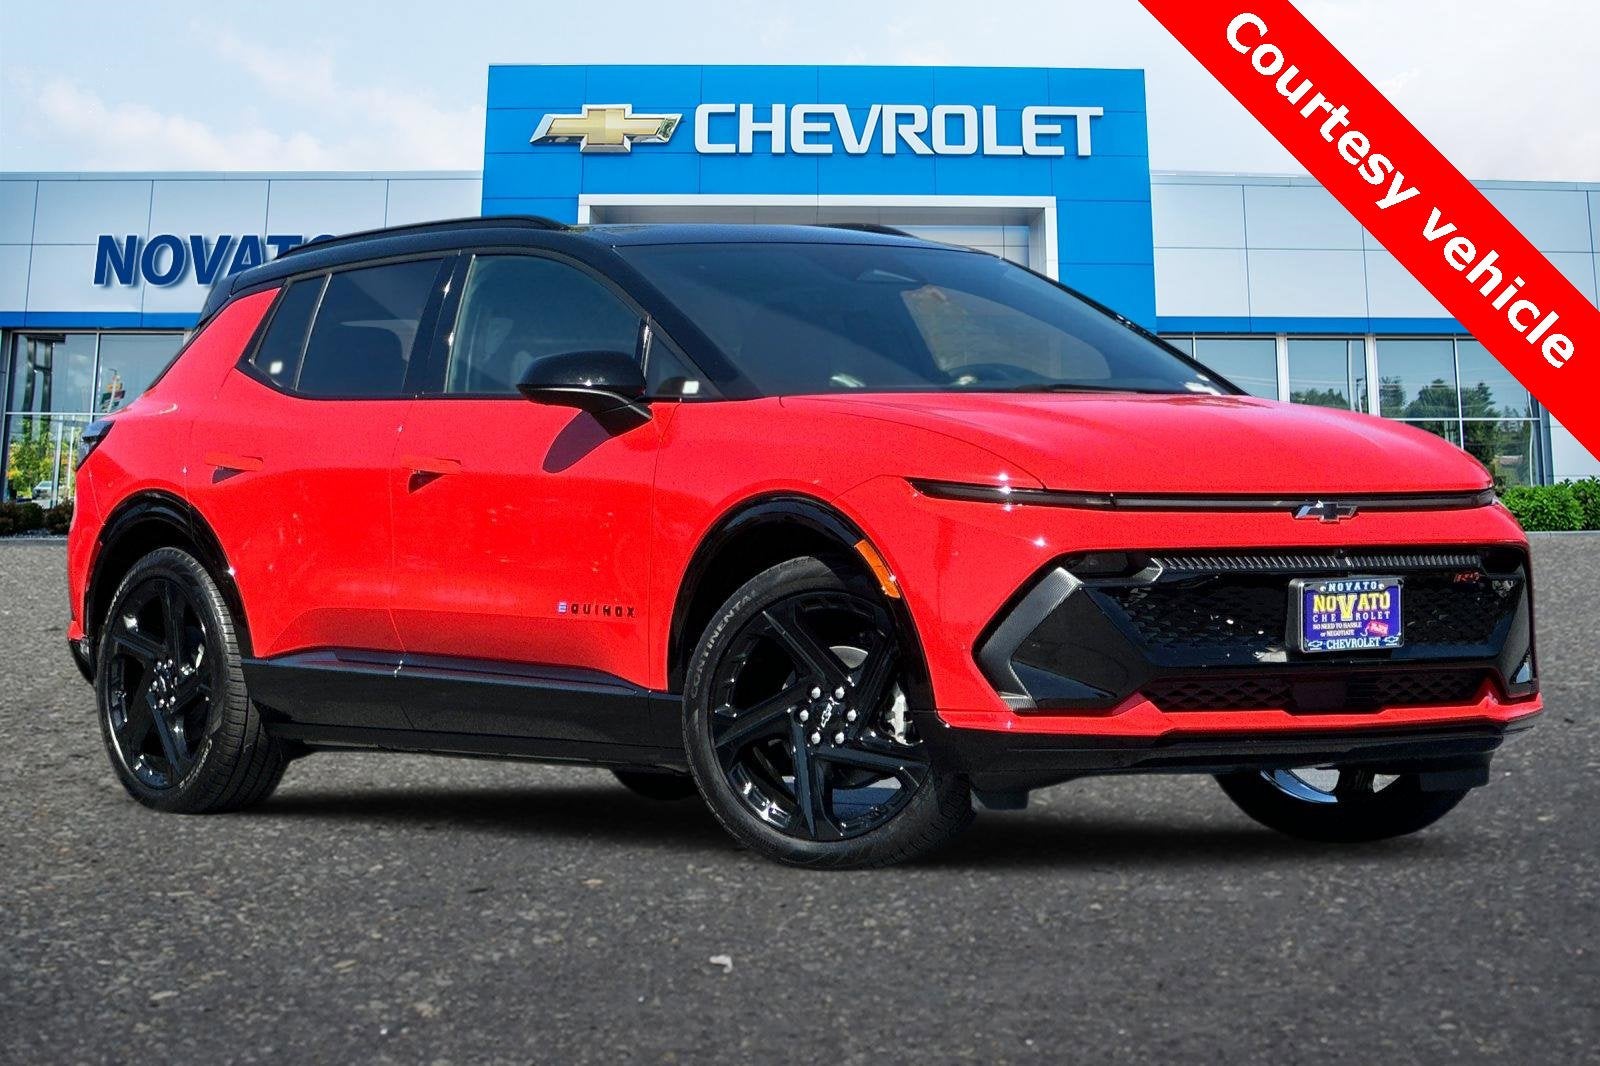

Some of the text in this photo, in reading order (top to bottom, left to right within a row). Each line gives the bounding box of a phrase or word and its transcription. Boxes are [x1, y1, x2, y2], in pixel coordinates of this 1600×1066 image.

[694, 103, 1104, 156] CHEVROLET
[93, 233, 339, 287] NOVAT
[1328, 581, 1377, 592] NOVATO
[557, 602, 635, 618] EQUINOX
[1313, 590, 1391, 621] NOVATO
[1326, 637, 1382, 650] CHEVROLET
